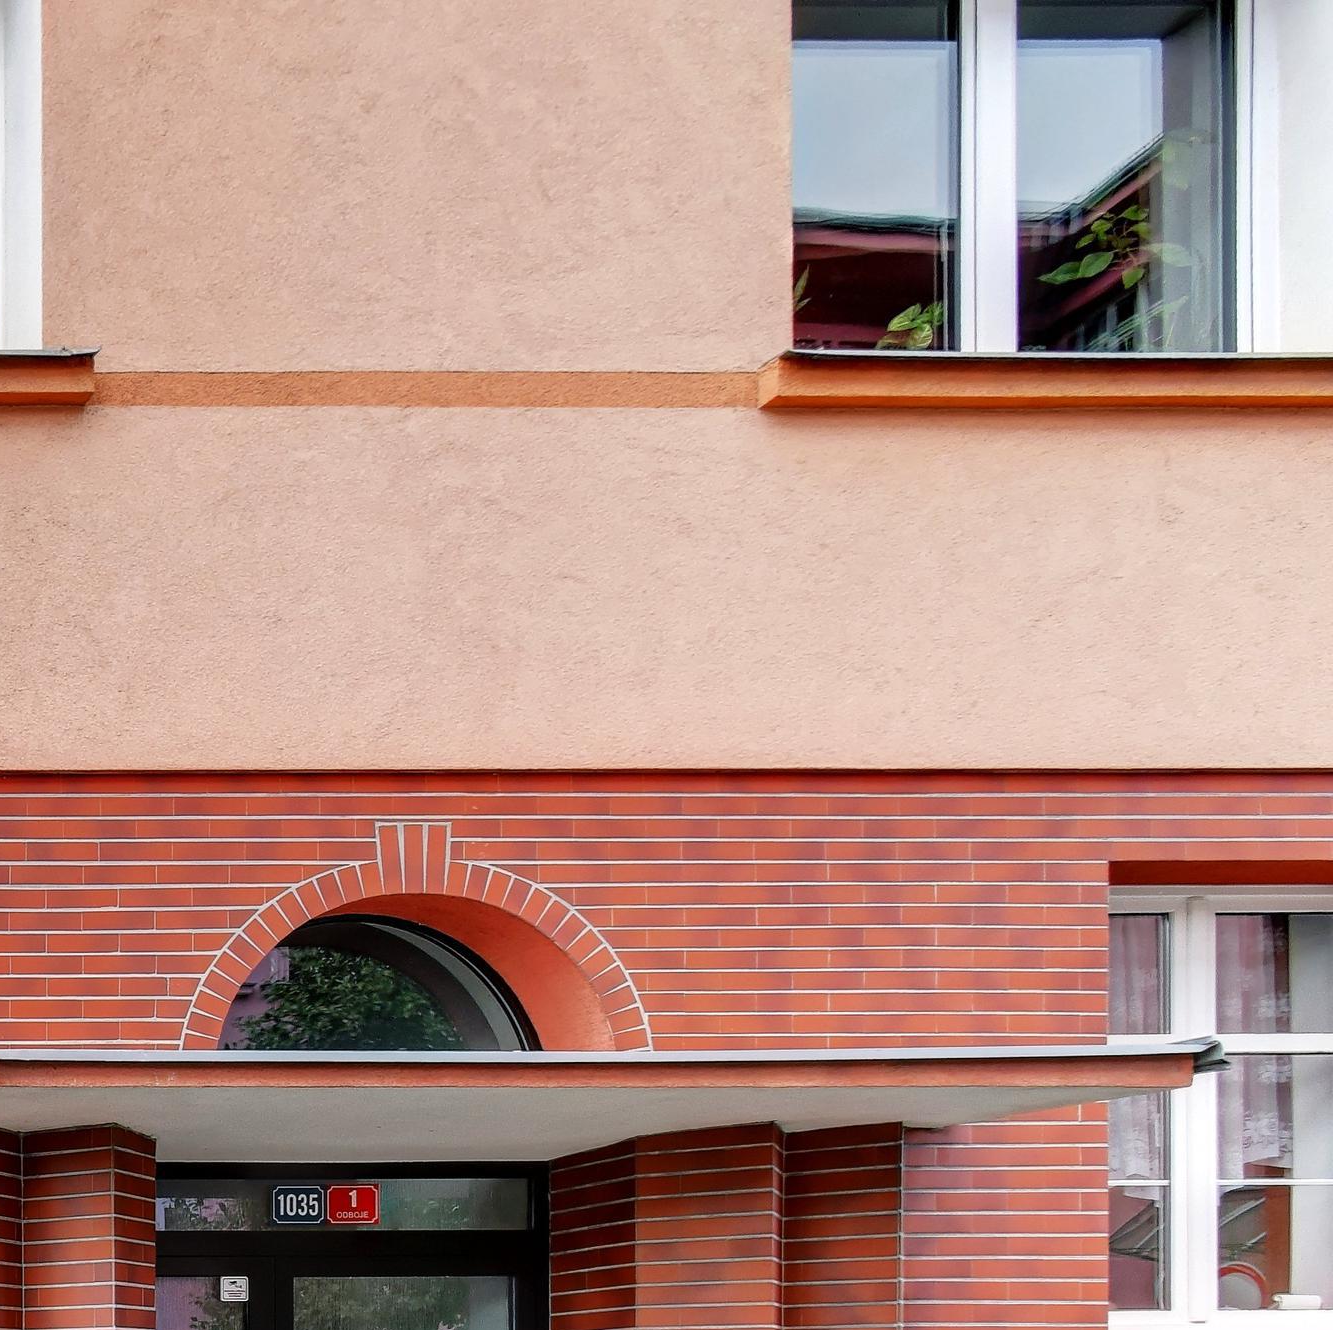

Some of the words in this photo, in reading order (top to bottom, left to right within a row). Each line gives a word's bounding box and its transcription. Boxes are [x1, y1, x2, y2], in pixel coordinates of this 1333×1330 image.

[278, 1193, 319, 1216] 1035
[348, 1190, 358, 1208] 1
[336, 1211, 369, 1220] ODBOJE
